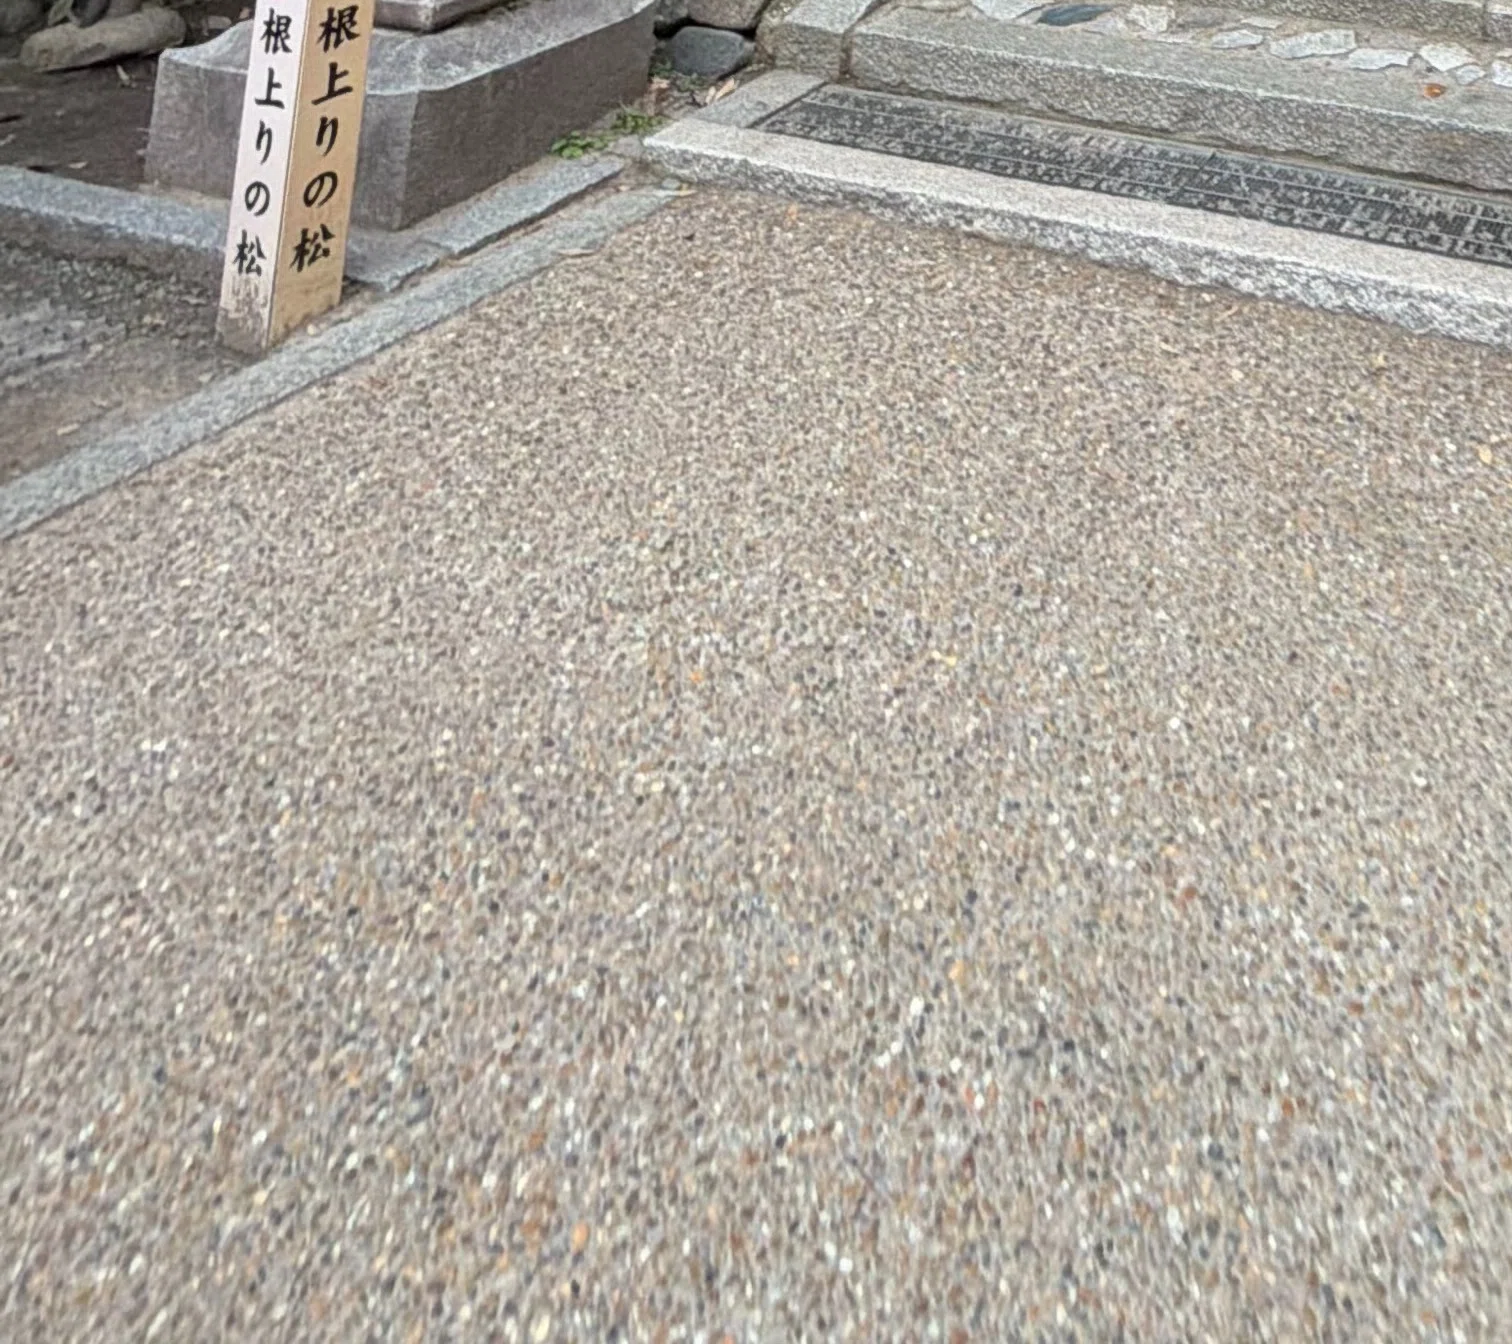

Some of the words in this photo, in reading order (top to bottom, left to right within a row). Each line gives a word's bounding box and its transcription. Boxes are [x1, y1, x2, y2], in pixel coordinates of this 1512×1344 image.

[232, 7, 293, 278] 根上りの松
[288, 4, 361, 274] 根上りの松
